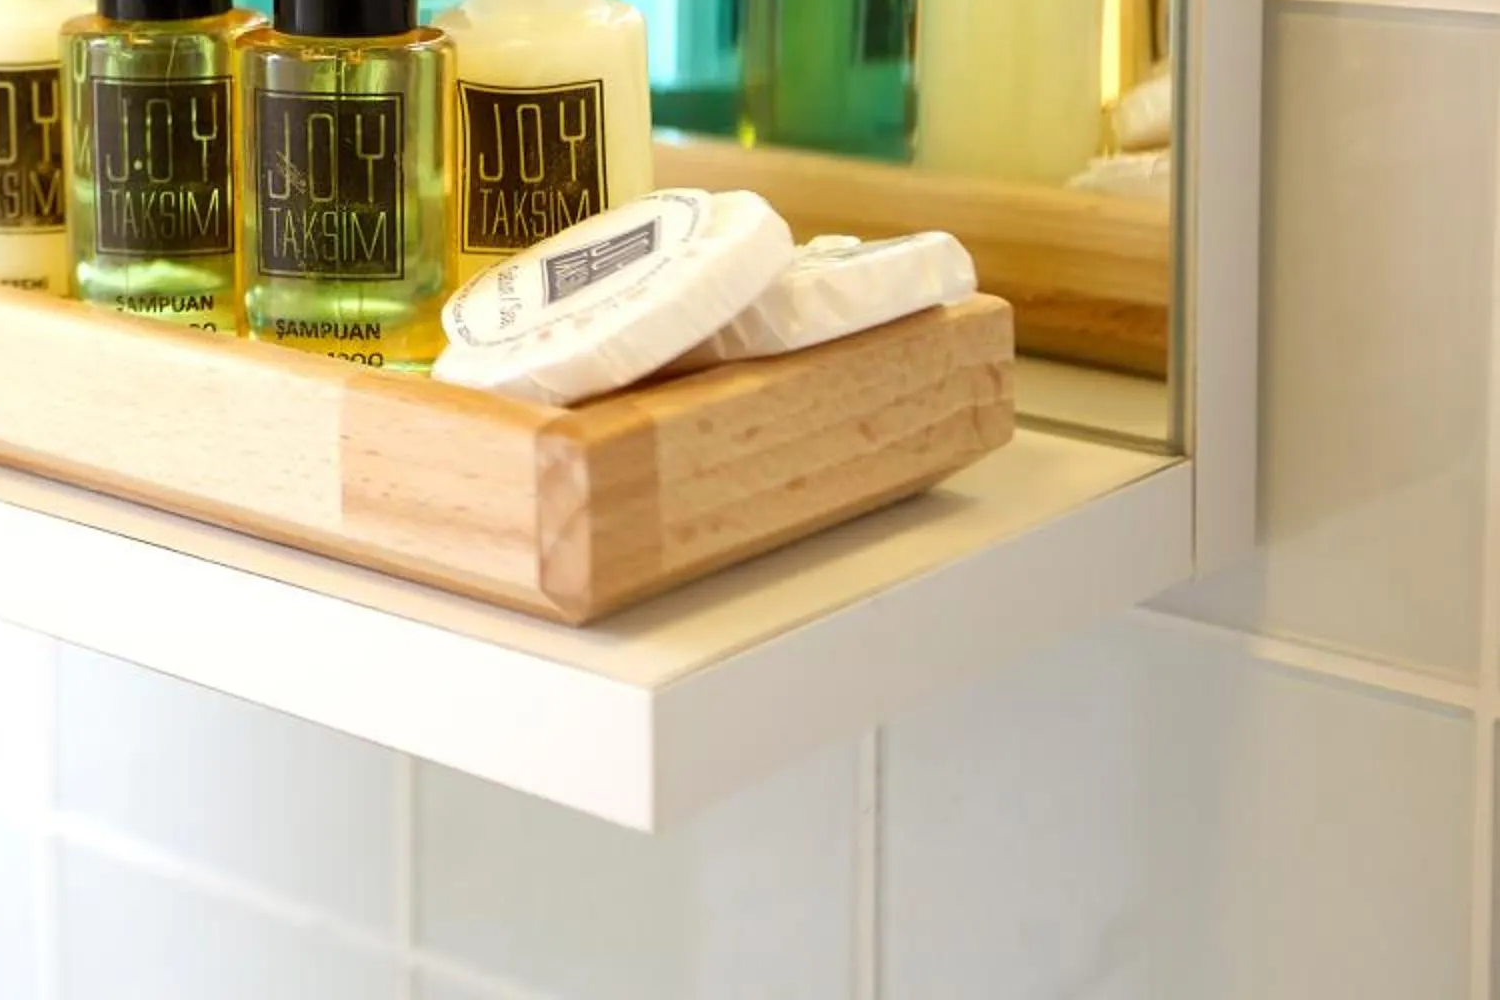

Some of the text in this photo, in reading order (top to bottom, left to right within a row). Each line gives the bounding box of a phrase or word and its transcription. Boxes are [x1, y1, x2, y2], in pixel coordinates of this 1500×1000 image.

[105, 92, 218, 184] JOY
[267, 110, 386, 204] JOY
[478, 100, 587, 184] JOY
